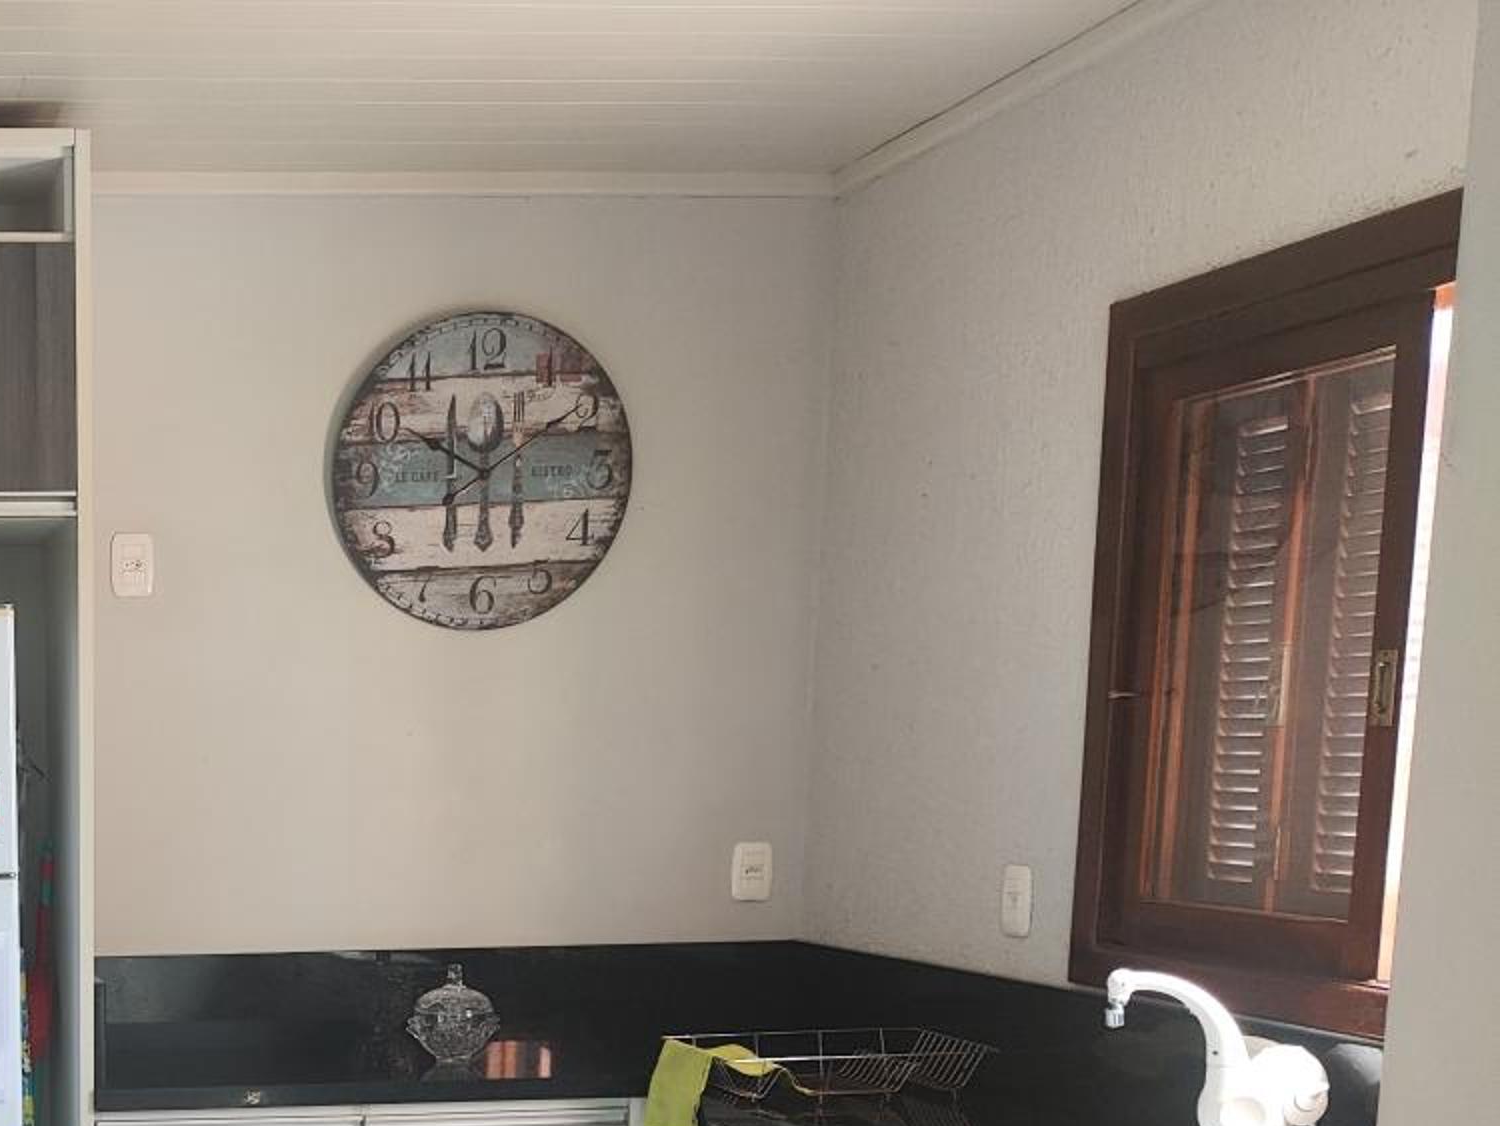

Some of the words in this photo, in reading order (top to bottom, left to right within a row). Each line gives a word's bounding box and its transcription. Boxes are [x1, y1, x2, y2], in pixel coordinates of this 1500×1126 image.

[468, 328, 507, 370] 12
[408, 350, 432, 392] 11
[368, 401, 401, 443] 10
[575, 393, 599, 431] 2
[355, 460, 379, 498] 9
[587, 449, 613, 490] 3
[372, 521, 396, 558] 8
[565, 509, 594, 546] 4
[416, 568, 437, 603] 7
[469, 575, 498, 614] 6
[527, 559, 552, 594] 5
